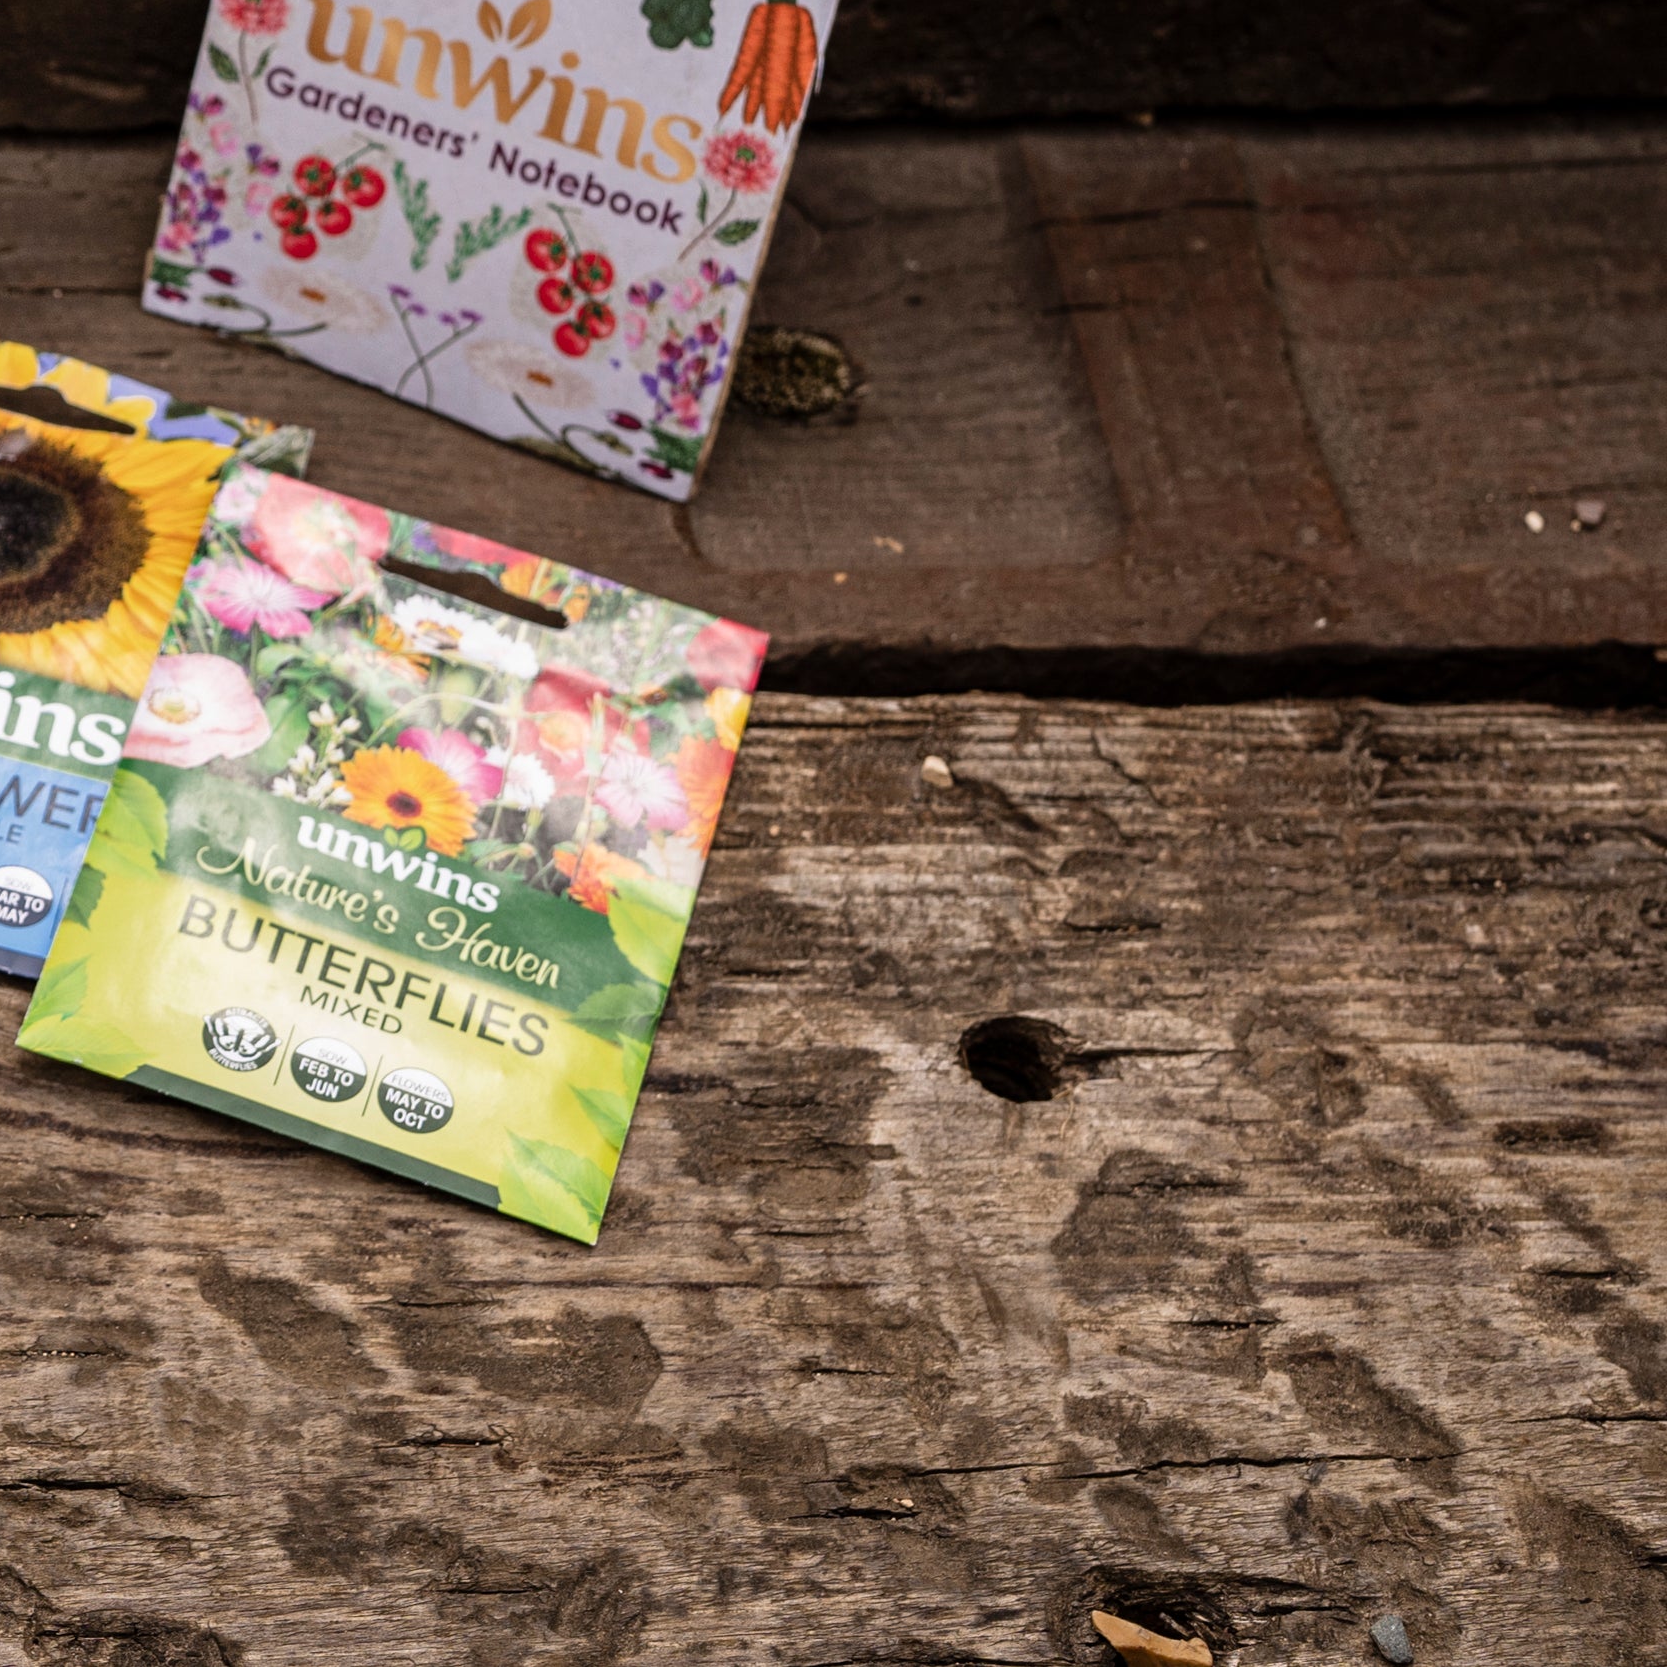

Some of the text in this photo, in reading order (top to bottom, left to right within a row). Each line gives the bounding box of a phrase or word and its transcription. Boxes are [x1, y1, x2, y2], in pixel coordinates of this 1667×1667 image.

[265, 66, 685, 234] Gardeners' Notebook
[297, 815, 501, 913] unwins
[24, 895, 45, 913] TO
[196, 835, 560, 990] Nature's Haven
[177, 893, 550, 1057] BUTTERFLIES
[299, 984, 403, 1035] MIXED
[318, 1047, 349, 1065] SOW
[298, 1057, 354, 1087] FEB TO
[305, 1078, 340, 1099] JUN
[385, 1088, 445, 1119] MAY TO
[391, 1074, 449, 1103] FLOWERS
[393, 1109, 427, 1129] OCT
